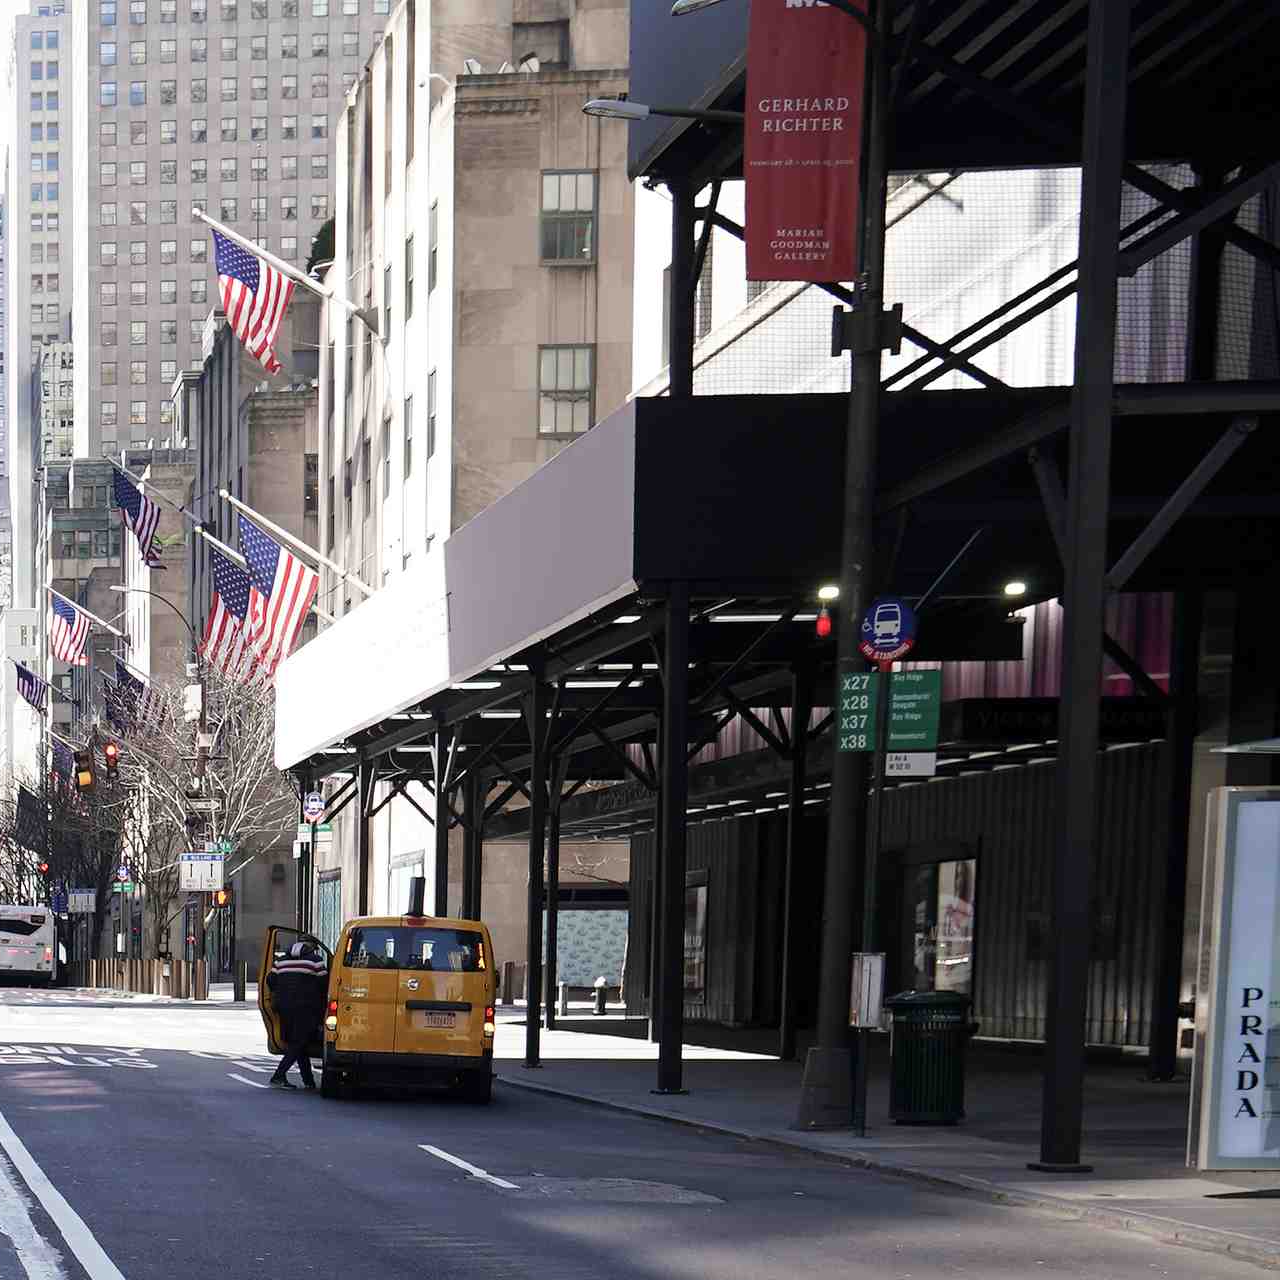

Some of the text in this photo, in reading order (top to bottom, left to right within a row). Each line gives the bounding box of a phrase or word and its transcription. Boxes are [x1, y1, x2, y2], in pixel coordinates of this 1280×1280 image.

[758, 97, 849, 113] GERHARD
[763, 118, 844, 133] RICHTER
[770, 241, 831, 250] GOODMAN
[774, 252, 827, 261] GALLERY
[1234, 987, 1264, 1118] PRADA
